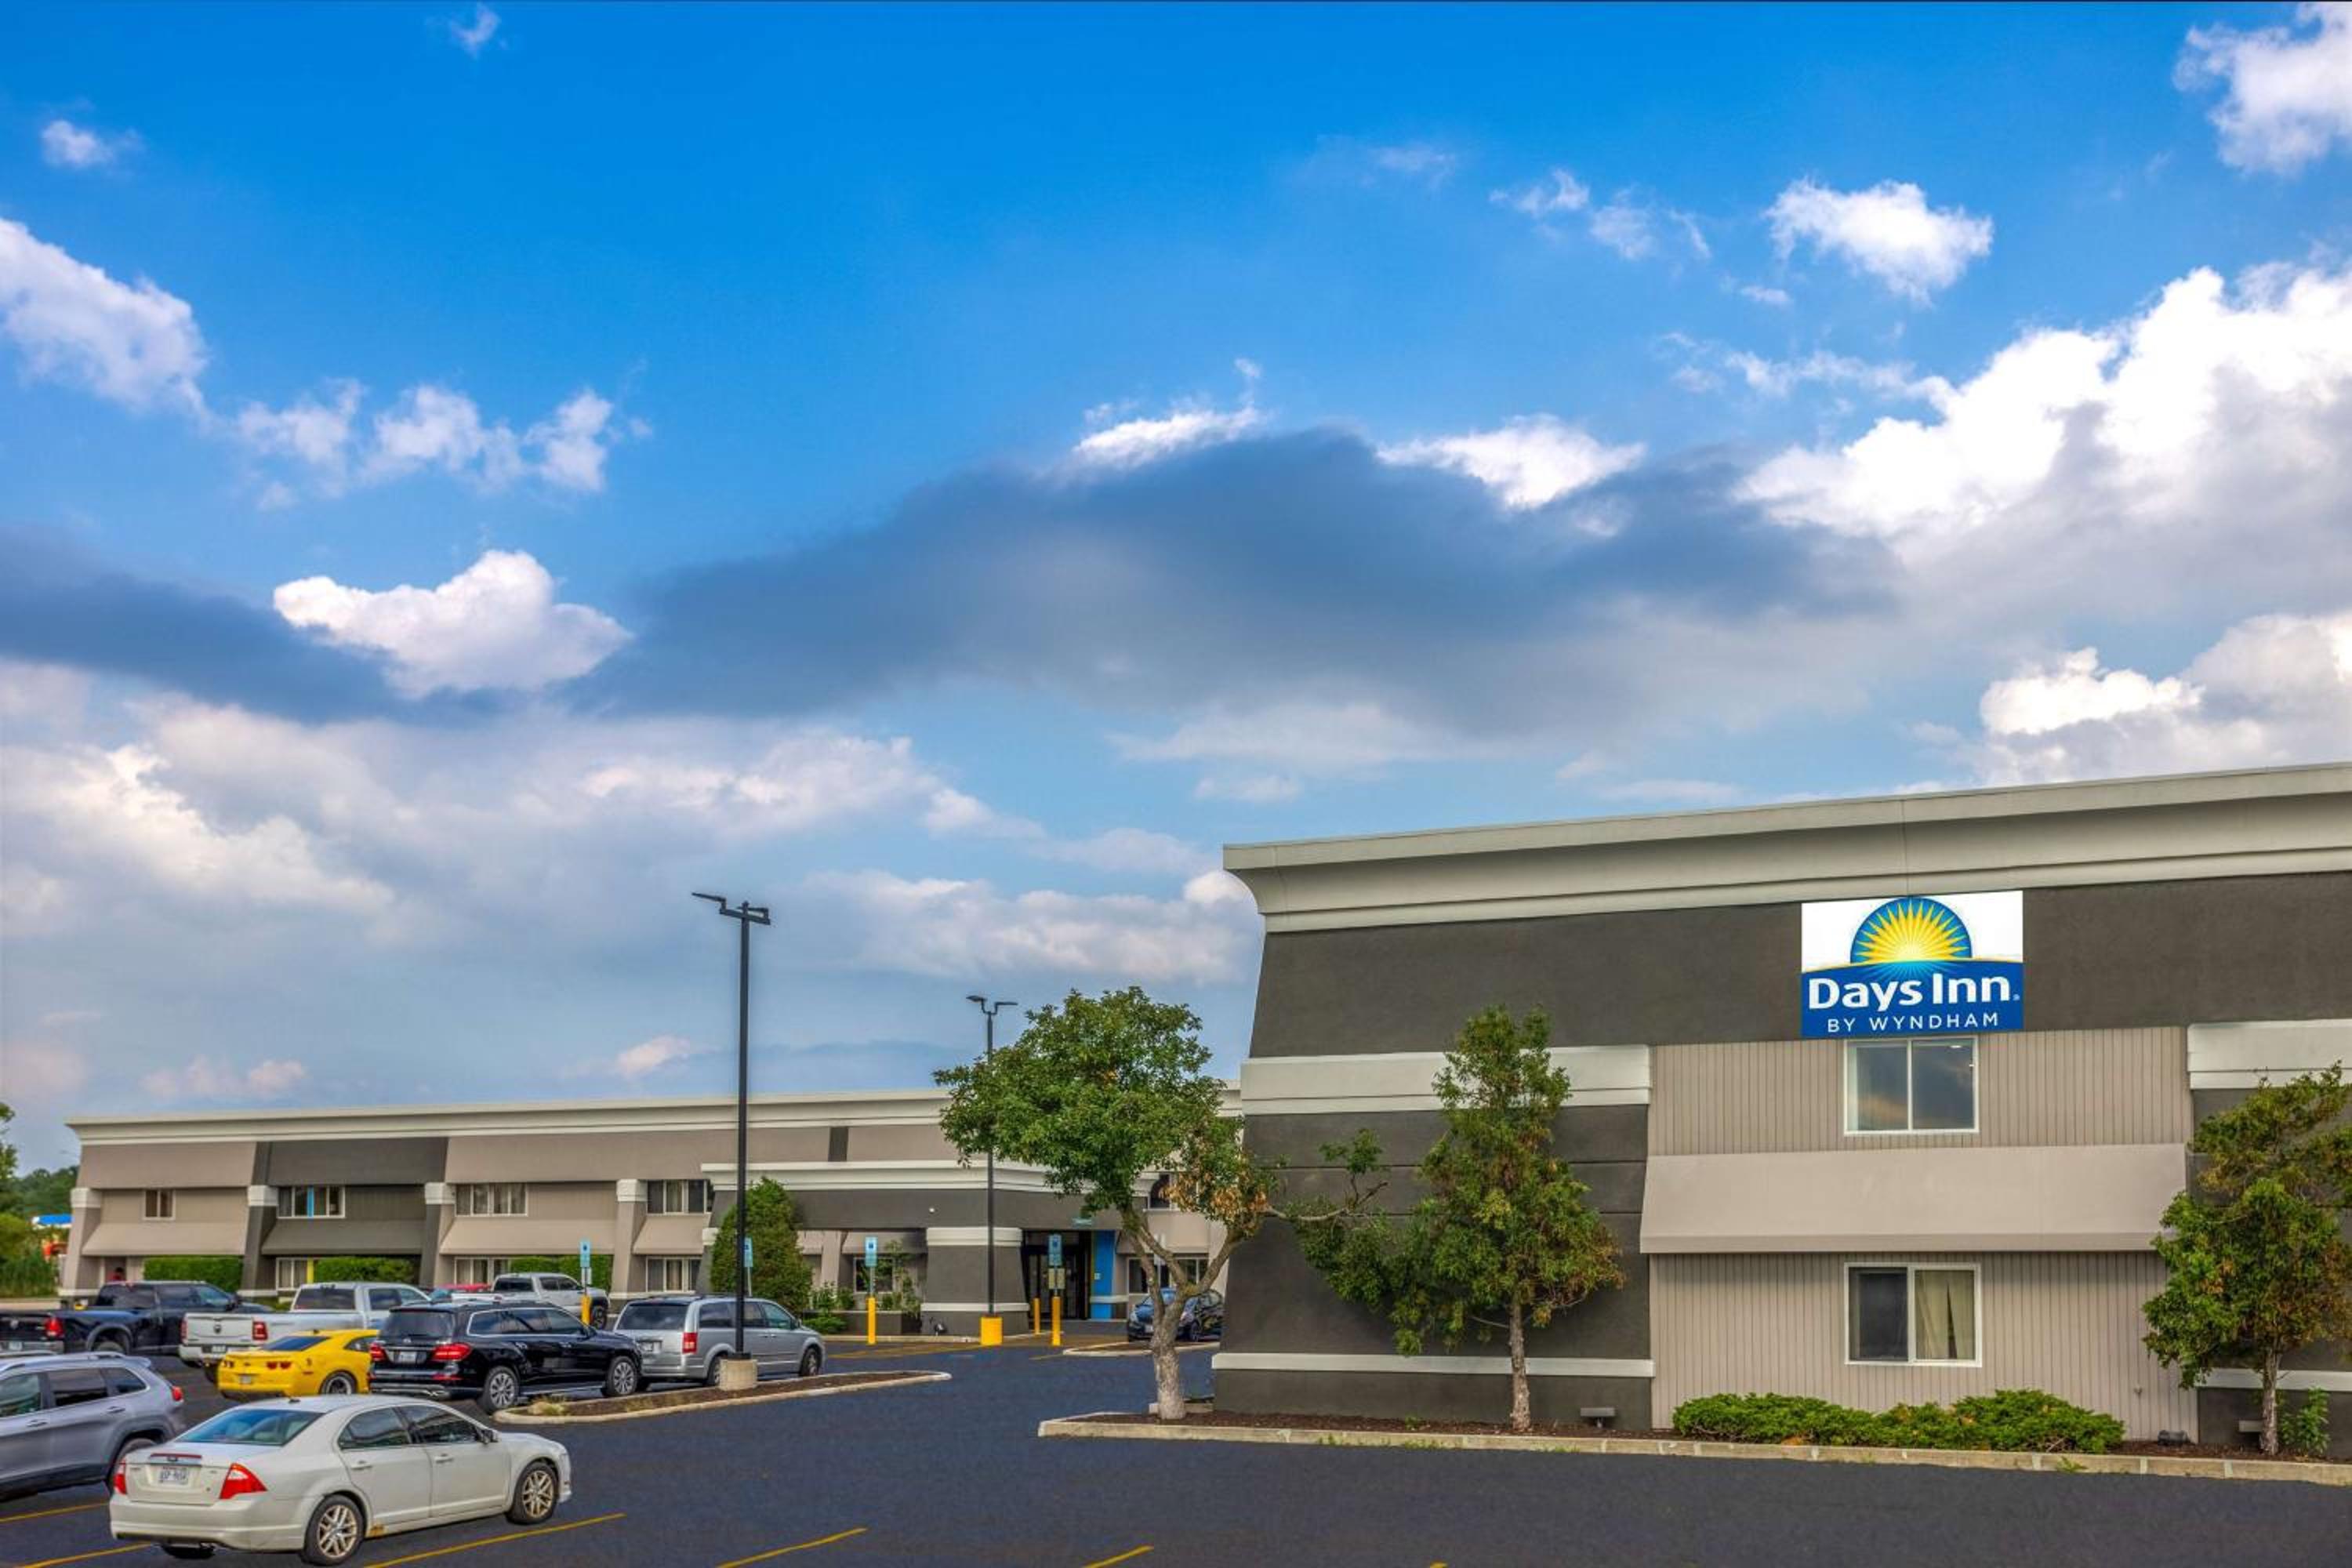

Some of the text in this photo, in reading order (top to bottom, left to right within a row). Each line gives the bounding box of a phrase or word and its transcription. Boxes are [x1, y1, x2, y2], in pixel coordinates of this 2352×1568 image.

[1809, 973, 2010, 1011] Days Inn
[1828, 1012, 1998, 1033] BY WYNDHAM
